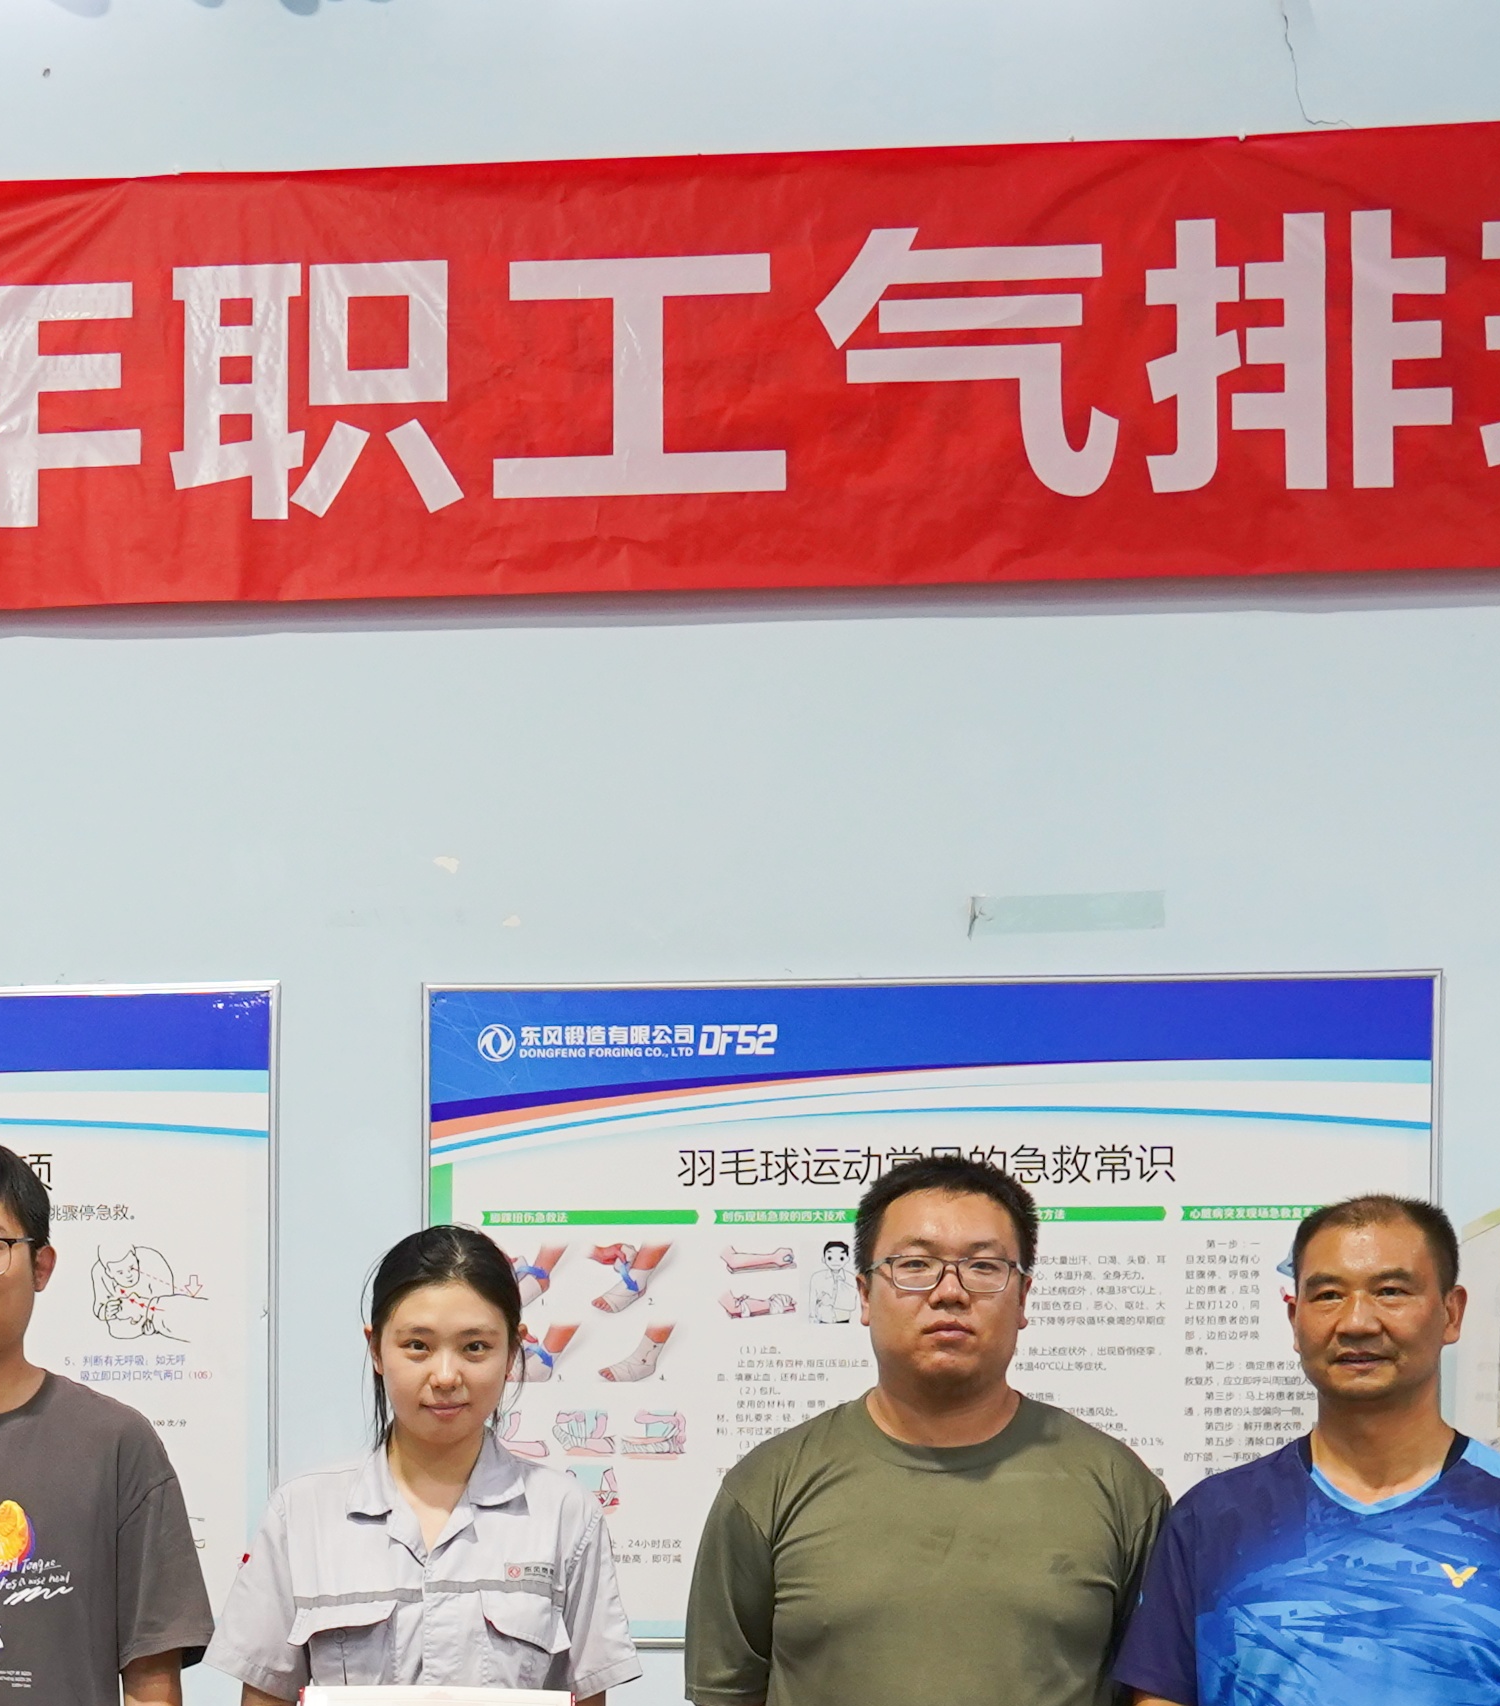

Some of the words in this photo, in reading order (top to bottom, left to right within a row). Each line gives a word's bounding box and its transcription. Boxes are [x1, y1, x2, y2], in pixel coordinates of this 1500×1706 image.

[520, 1024, 695, 1047] 东风锻造有限公司
[698, 1023, 778, 1056] DF52
[519, 1048, 586, 1059] DONGFENG
[588, 1047, 643, 1059] FORGING
